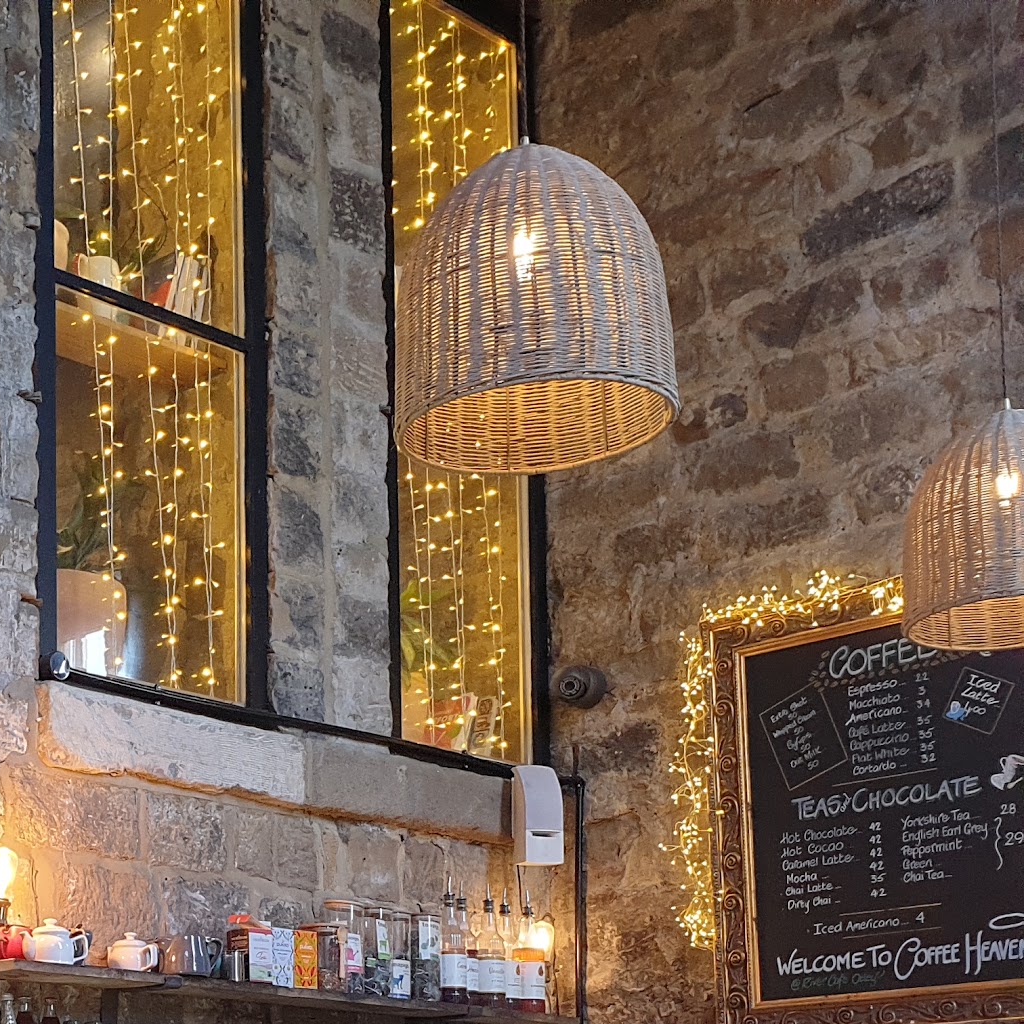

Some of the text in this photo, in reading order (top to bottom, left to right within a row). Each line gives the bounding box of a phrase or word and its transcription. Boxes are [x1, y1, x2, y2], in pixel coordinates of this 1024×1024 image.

[848, 679, 897, 698] Espresso
[961, 686, 1000, 705] Latte
[967, 674, 1001, 693] Iced
[849, 686, 926, 711] Macchiato 3
[845, 698, 931, 726] Americano 34
[871, 722, 906, 735] Latte
[917, 715, 932, 725] 35
[849, 727, 936, 752] Cappuccino 35
[804, 745, 822, 760] Milk
[852, 740, 936, 765] Flat White 35
[920, 752, 937, 763] 32
[791, 794, 841, 820] TEAS
[852, 776, 982, 812] CHOCOLATE
[901, 803, 1017, 831] Yorkshire Tea 28
[780, 822, 881, 844] Hot Chocolate 42
[902, 822, 1024, 847] English Earl Grey 29
[781, 845, 802, 858] Hot
[869, 834, 882, 844] 42
[901, 838, 963, 859] Peppermint
[782, 847, 883, 871] Caramel Latte 42
[902, 858, 933, 870] Green
[786, 860, 885, 884] Mocha 42
[903, 869, 944, 883] Chai Tea
[785, 872, 887, 897] Chai Latte 35
[787, 888, 887, 914] Dirty Chai 42
[813, 911, 926, 936] Iced Americano 4
[776, 948, 866, 976] WELCOME
[894, 937, 961, 981] COFFEE
